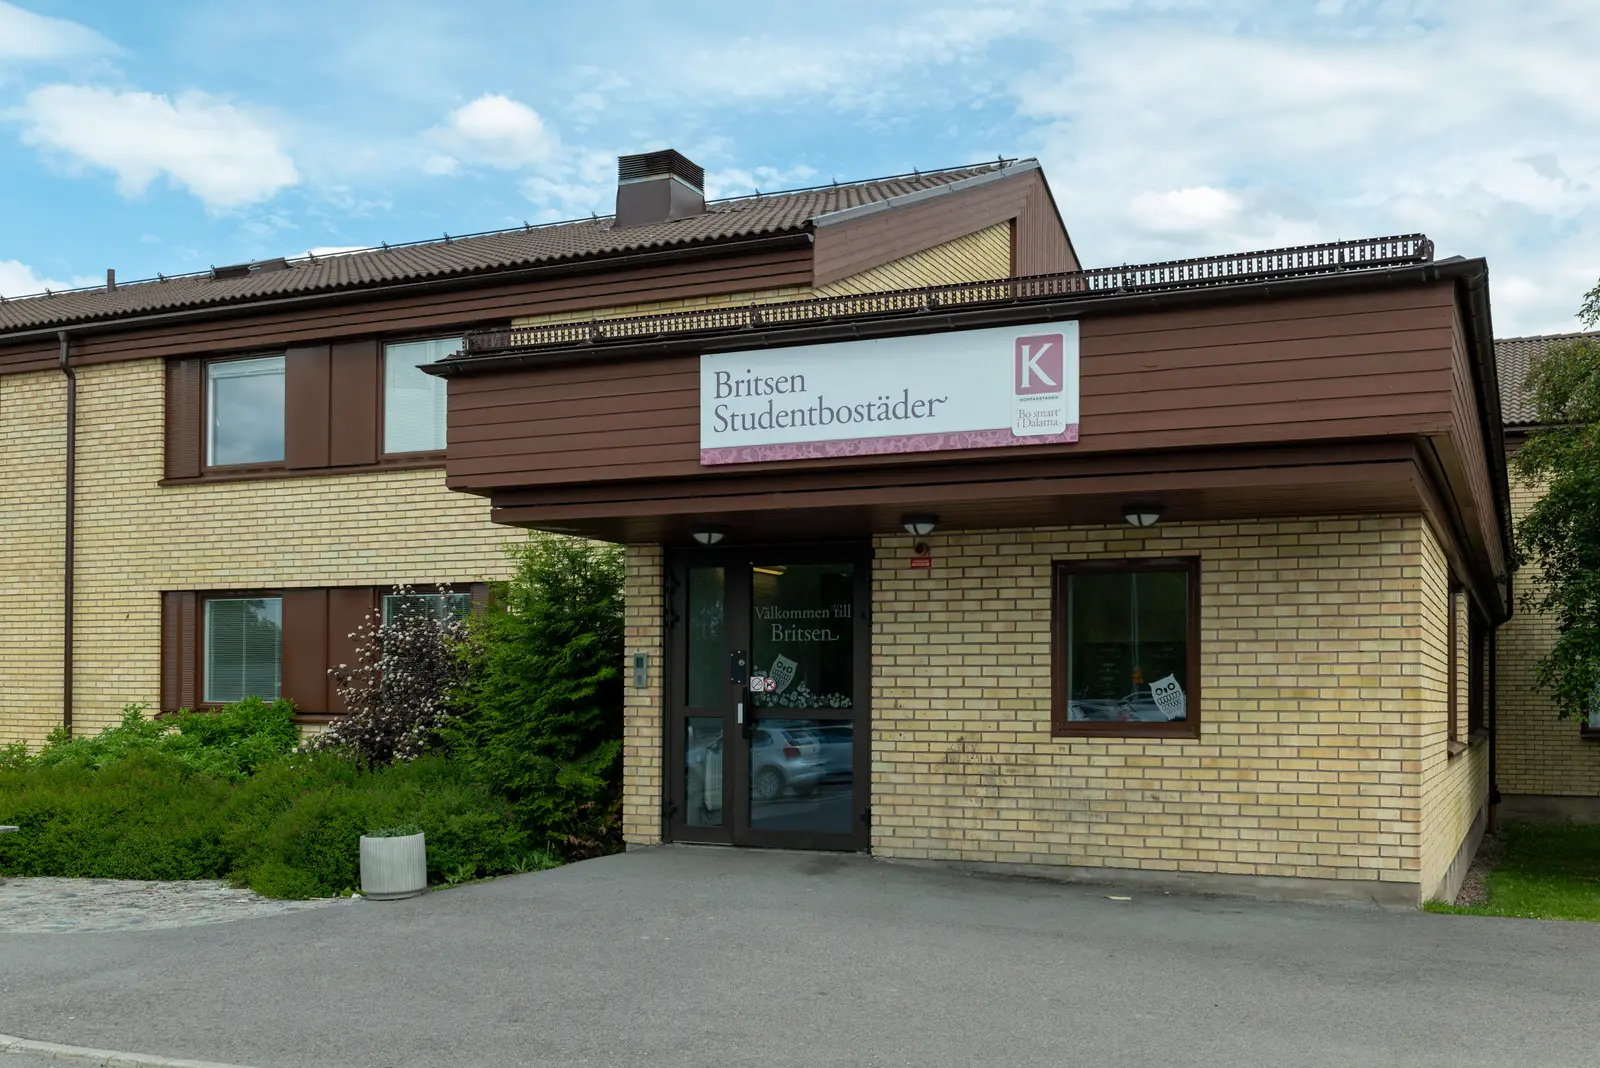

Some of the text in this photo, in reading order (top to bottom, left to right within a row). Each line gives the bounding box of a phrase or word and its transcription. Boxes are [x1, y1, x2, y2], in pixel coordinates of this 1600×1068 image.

[1021, 343, 1057, 388] K
[713, 368, 807, 399] Britsen
[713, 388, 948, 433] Studentbostäder
[1018, 409, 1061, 419] Bo smart
[755, 603, 852, 619] Välkommen till
[770, 623, 840, 642] Britsen
